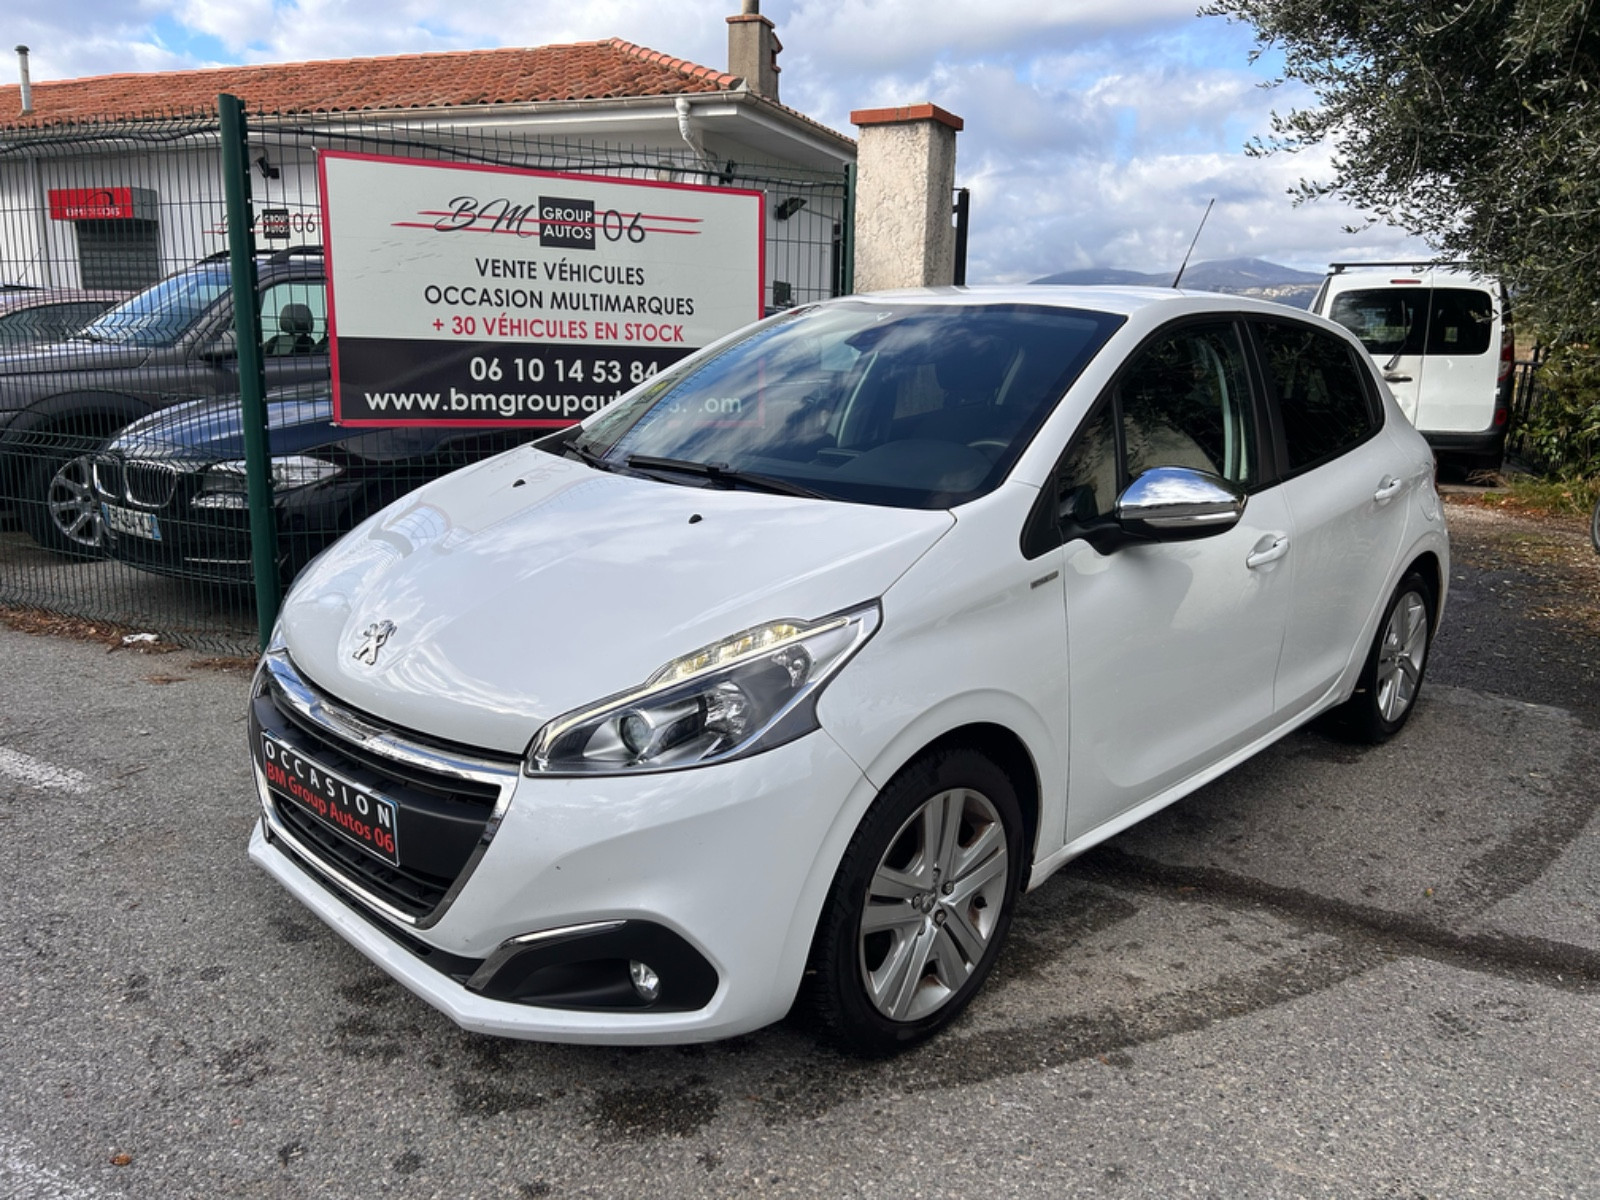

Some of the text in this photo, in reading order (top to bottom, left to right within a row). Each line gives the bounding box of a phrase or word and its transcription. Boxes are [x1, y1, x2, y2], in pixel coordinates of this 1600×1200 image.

[293, 212, 317, 234] 06
[433, 196, 535, 239] BM
[542, 206, 593, 224] GROUP
[602, 209, 646, 244] 06
[542, 225, 593, 240] AUTOS
[475, 257, 645, 286] VENTE VÉHICULES
[424, 284, 695, 316] OCCASION MULTIMARQUES
[432, 312, 685, 343] + 30 VÉHICULES EN STOCK
[470, 356, 658, 384] 06 10 14 53 84
[265, 741, 390, 828] OCCASION
[266, 761, 395, 853] BM Group Autos 06
